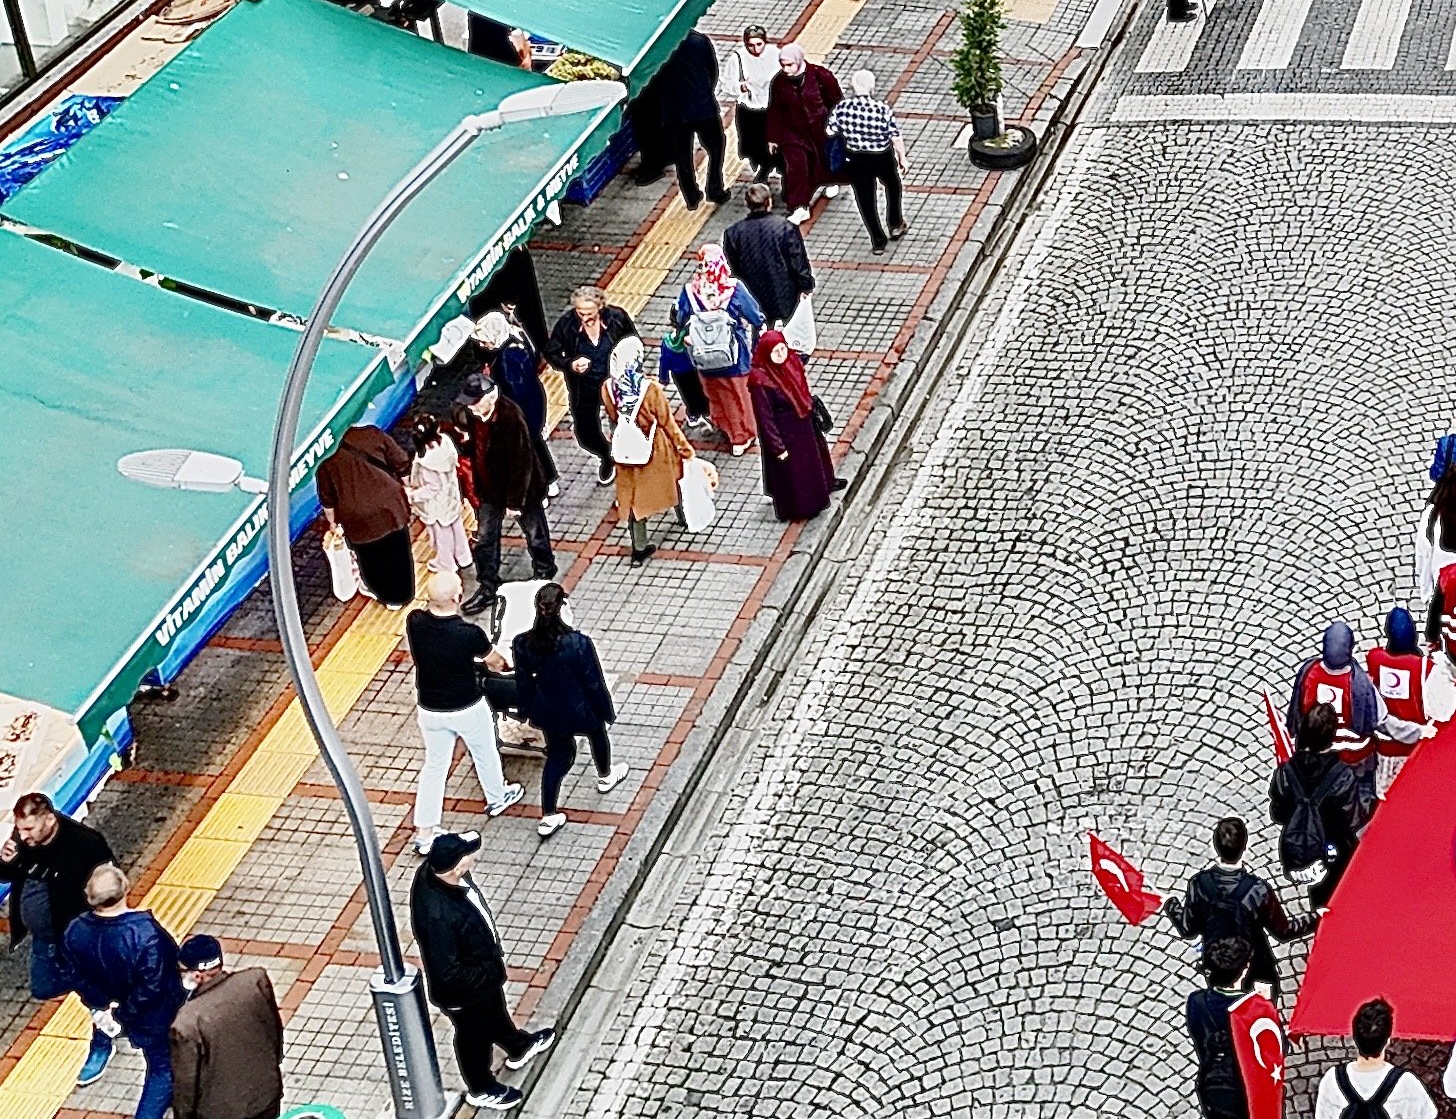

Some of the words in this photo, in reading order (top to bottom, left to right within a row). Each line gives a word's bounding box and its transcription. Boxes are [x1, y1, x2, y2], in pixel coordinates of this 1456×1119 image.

[154, 558, 226, 647] VİTAMİN
[224, 503, 270, 566] BALIK
[1290, 860, 1327, 884] NIKE
